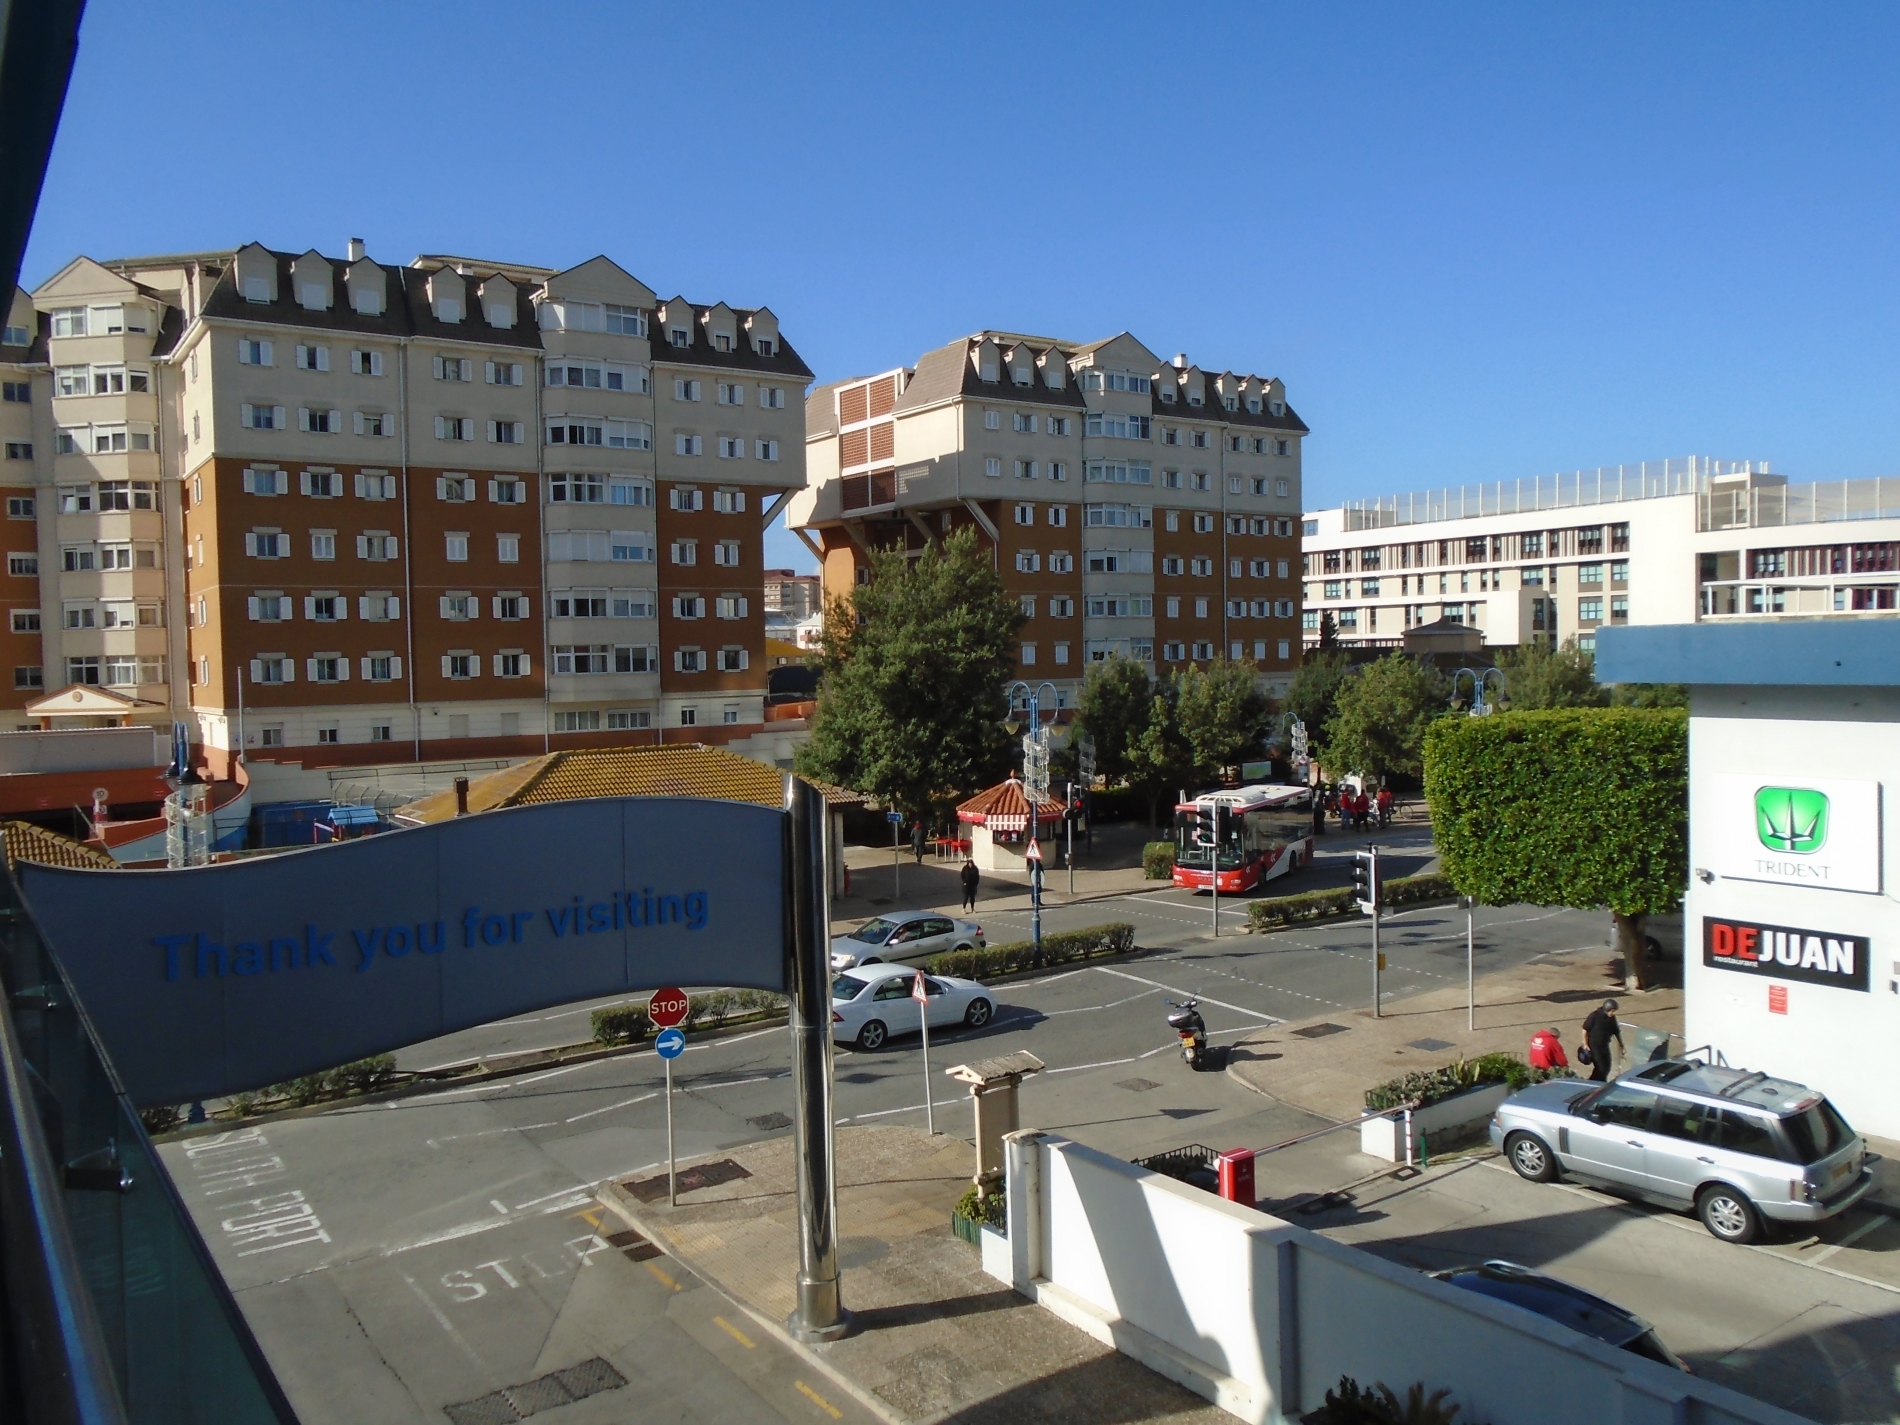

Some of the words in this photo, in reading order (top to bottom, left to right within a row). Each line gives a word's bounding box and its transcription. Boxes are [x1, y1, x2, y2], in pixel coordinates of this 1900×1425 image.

[1755, 859, 1832, 880] TRIDENT
[153, 924, 336, 982] Thank
[353, 921, 446, 973] you
[462, 906, 534, 949] for
[547, 888, 710, 938] visiting
[650, 999, 687, 1015] STOP
[215, 1189, 332, 1258] PORT
[441, 1234, 610, 1303] STOP
